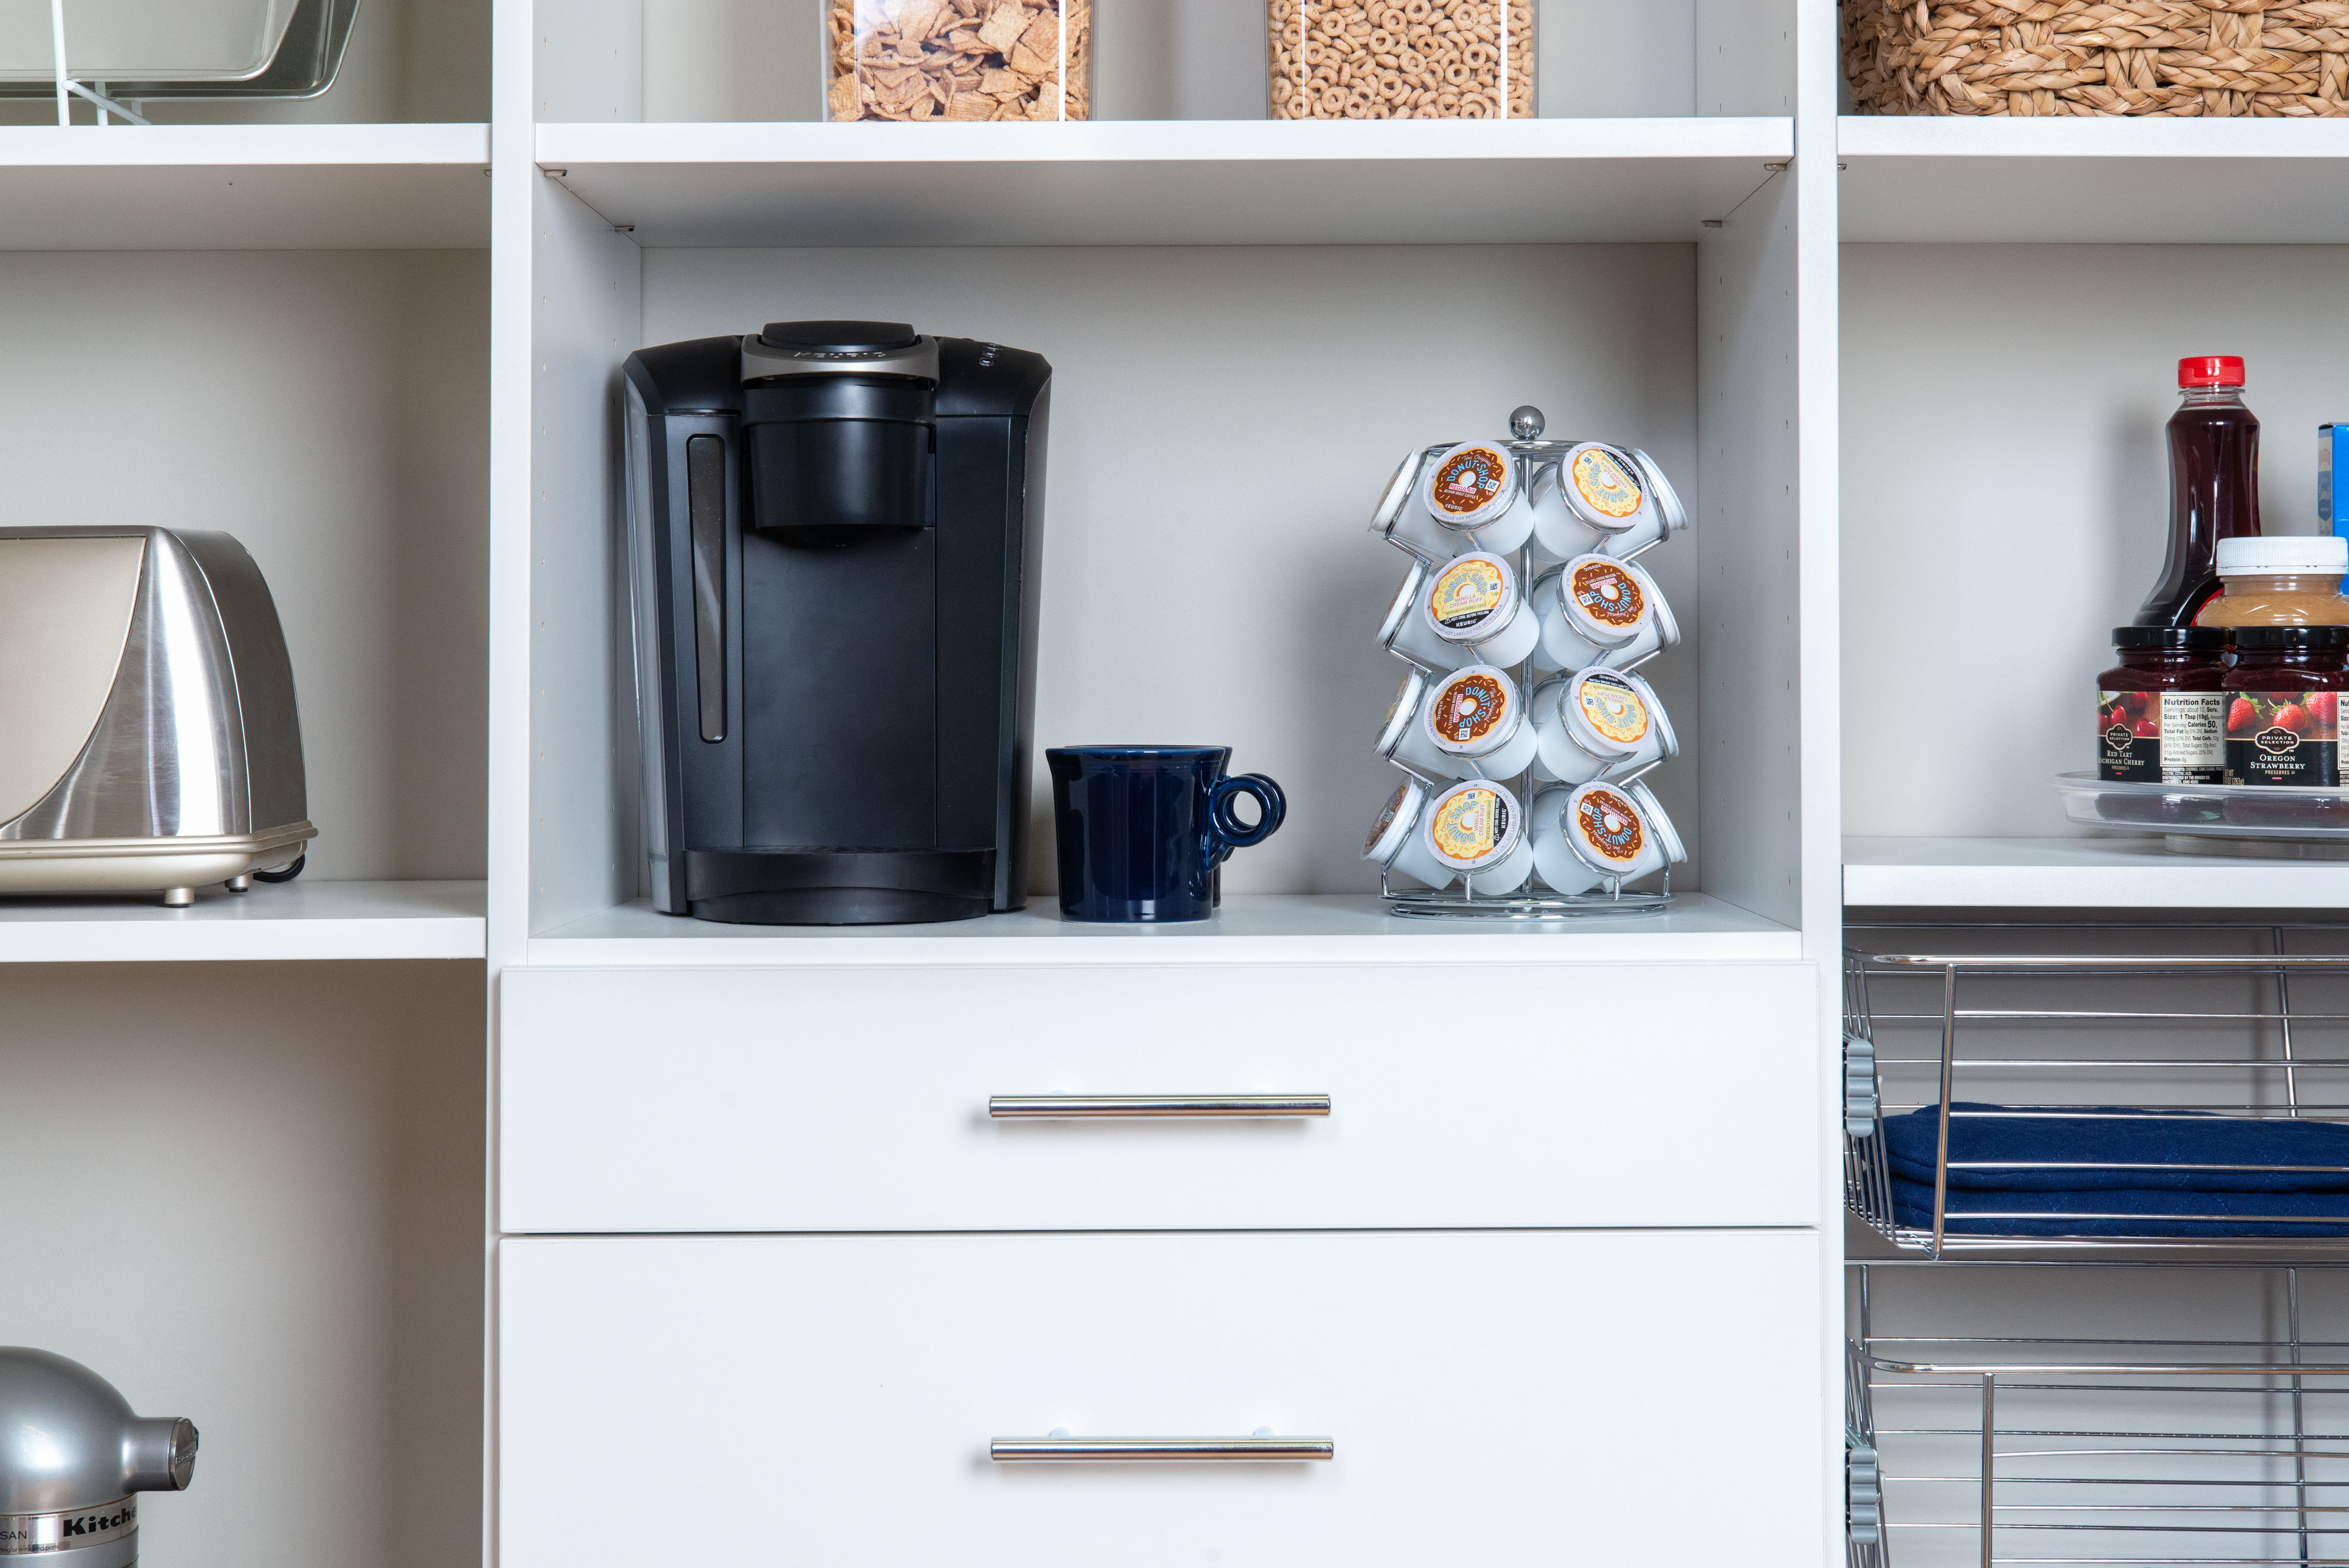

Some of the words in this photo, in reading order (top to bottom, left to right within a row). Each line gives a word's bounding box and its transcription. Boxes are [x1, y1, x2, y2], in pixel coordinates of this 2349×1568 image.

[1474, 454, 1495, 467] Original
[1618, 458, 1634, 474] KEURIG
[1604, 469, 1621, 487] VANILLA
[1612, 473, 1627, 488] CREAM
[1449, 484, 1475, 493] REGULAR
[1591, 578, 1617, 589] REGULAR
[1483, 615, 1495, 626] RETAIL
[1495, 604, 1503, 615] SALE
[1456, 619, 1477, 627] KEURIG
[1454, 695, 1463, 722] REGULAR
[1483, 699, 1498, 722] Original
[2207, 721, 2217, 729] 50,
[2250, 761, 2306, 769] STRAWBERRY
[1609, 795, 1627, 807] KEURIG
[1441, 809, 1452, 832] Original
[1602, 805, 1627, 825] REGULAR
[1590, 830, 1611, 850] Original
[0, 1531, 27, 1540] SAN
